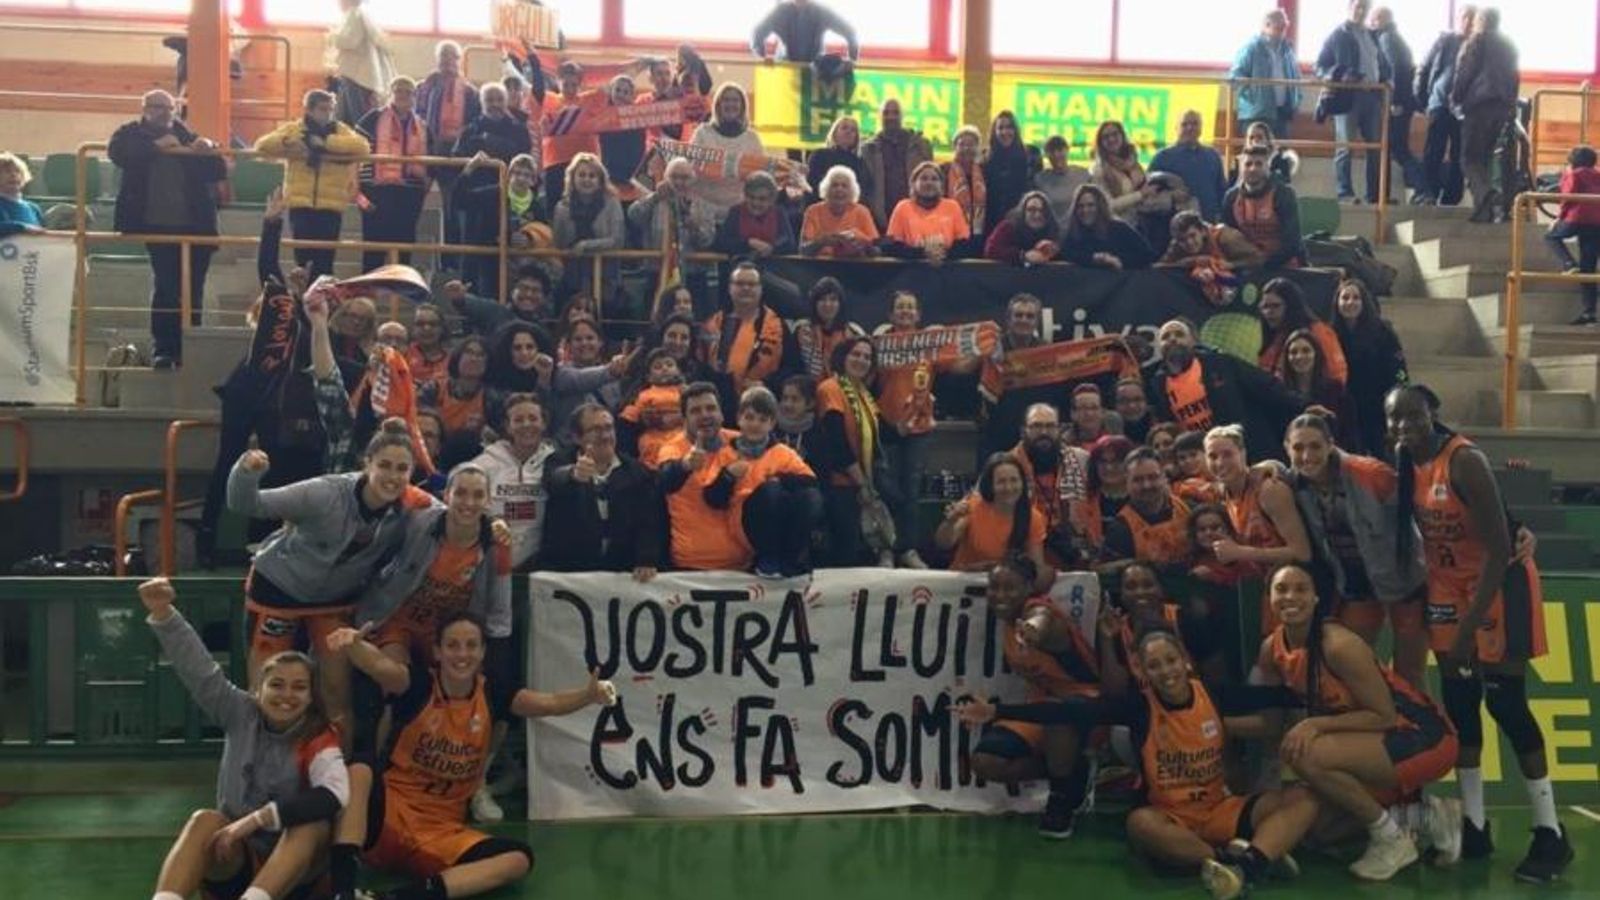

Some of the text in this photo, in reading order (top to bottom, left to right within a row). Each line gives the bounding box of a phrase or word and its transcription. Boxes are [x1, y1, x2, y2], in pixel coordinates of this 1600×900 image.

[812, 76, 951, 113] MANN
[1024, 91, 1161, 125] MANN
[734, 695, 804, 794] FA
